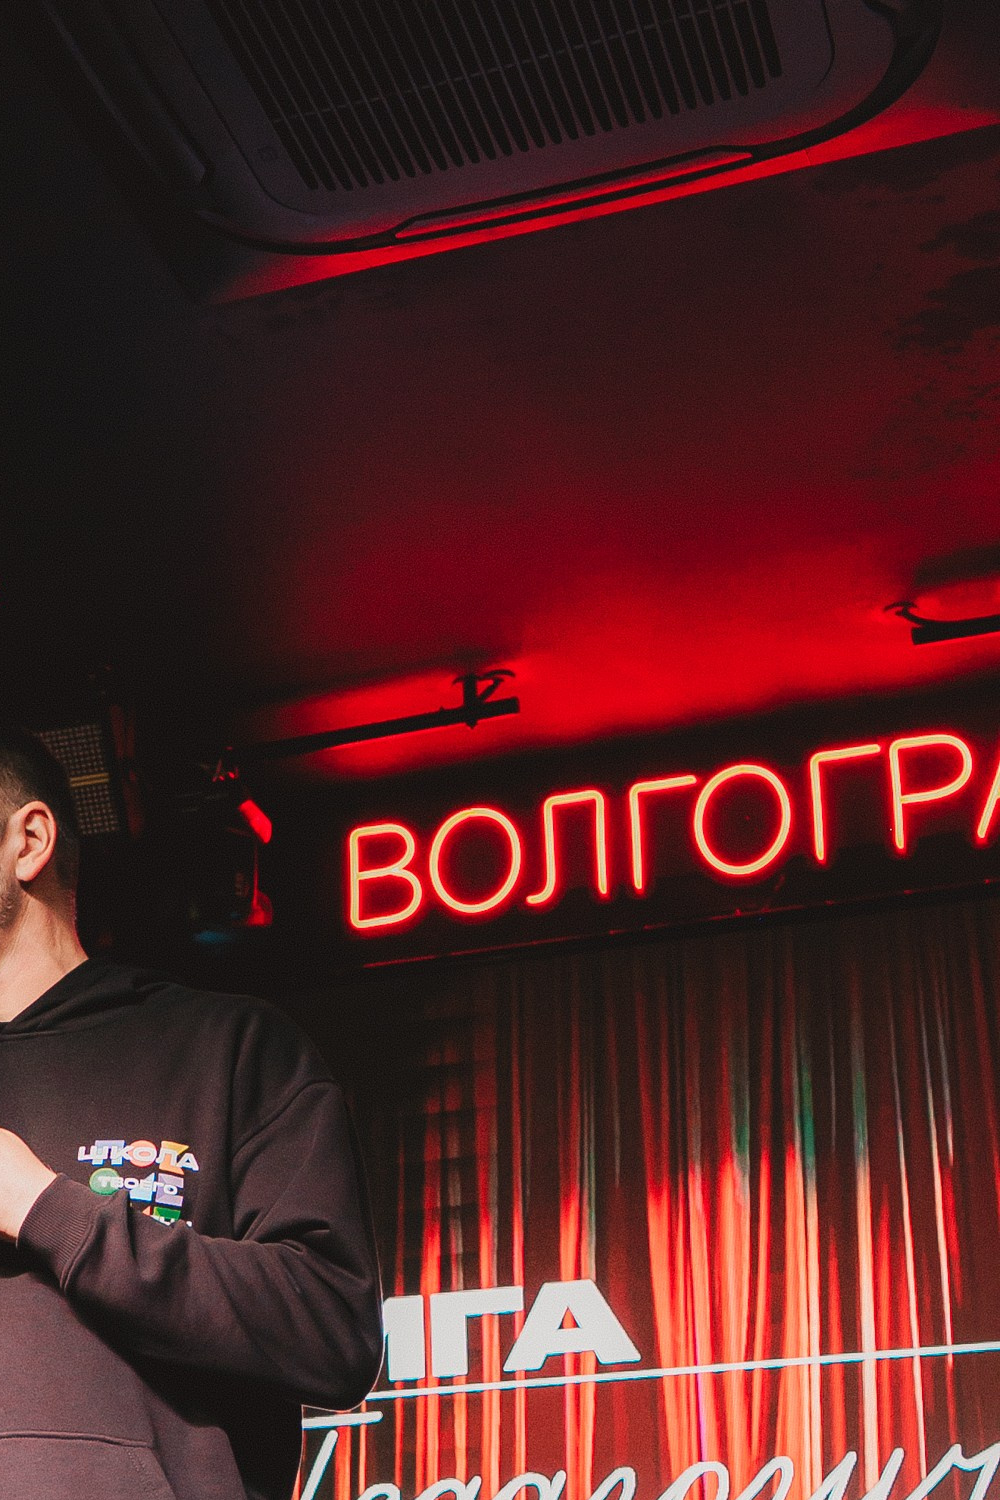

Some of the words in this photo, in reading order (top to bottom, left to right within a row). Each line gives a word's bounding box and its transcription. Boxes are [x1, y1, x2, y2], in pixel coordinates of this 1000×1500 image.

[347, 733, 1000, 930] ВОЛГОГР
[77, 1144, 200, 1173] ШКОЛА
[97, 1175, 179, 1196] ТВОЕГО
